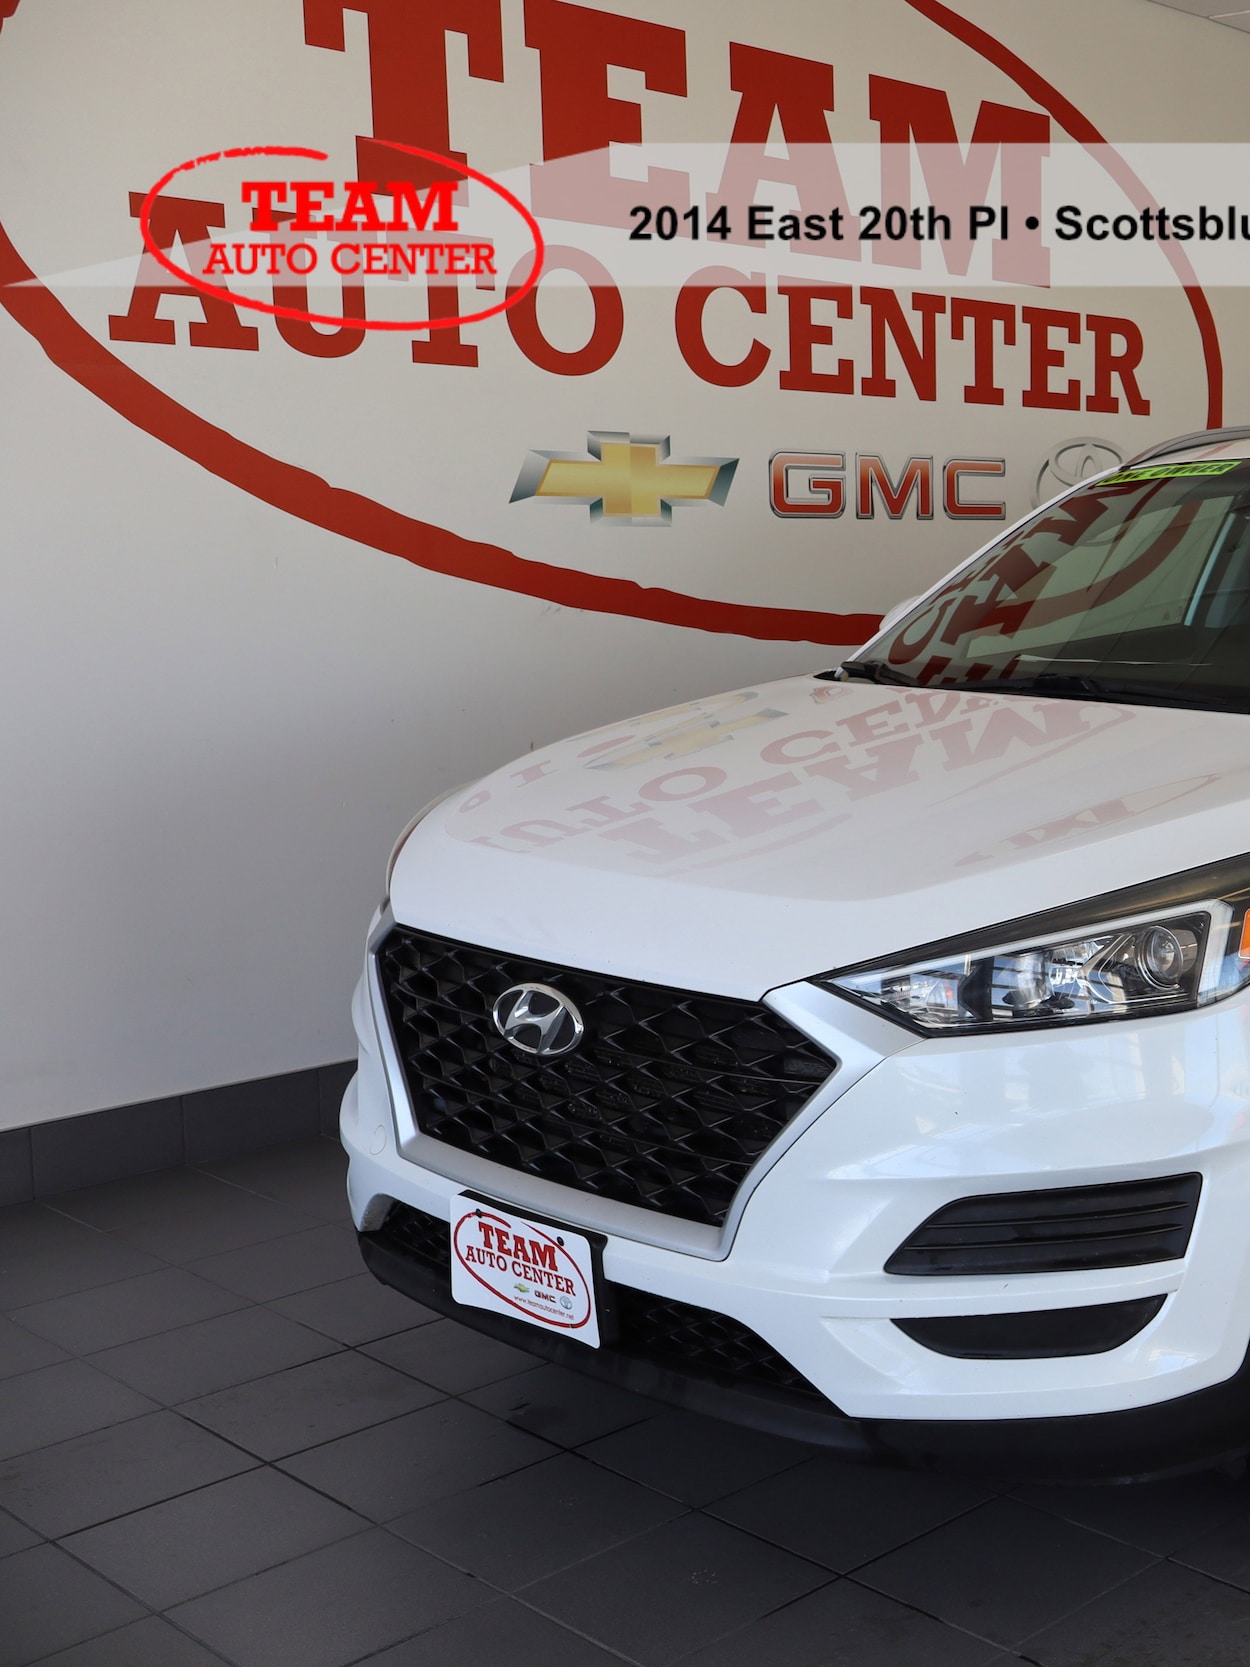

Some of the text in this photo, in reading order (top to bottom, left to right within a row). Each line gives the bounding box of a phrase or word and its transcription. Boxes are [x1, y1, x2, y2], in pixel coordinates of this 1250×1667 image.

[303, 0, 1050, 289] TEAM
[108, 191, 1150, 416] AUTO CENTER
[769, 450, 1006, 520] GMC
[465, 1245, 577, 1296] AUTO CENTER
[478, 1221, 558, 1272] TEAM
[534, 1289, 557, 1303] GMC
